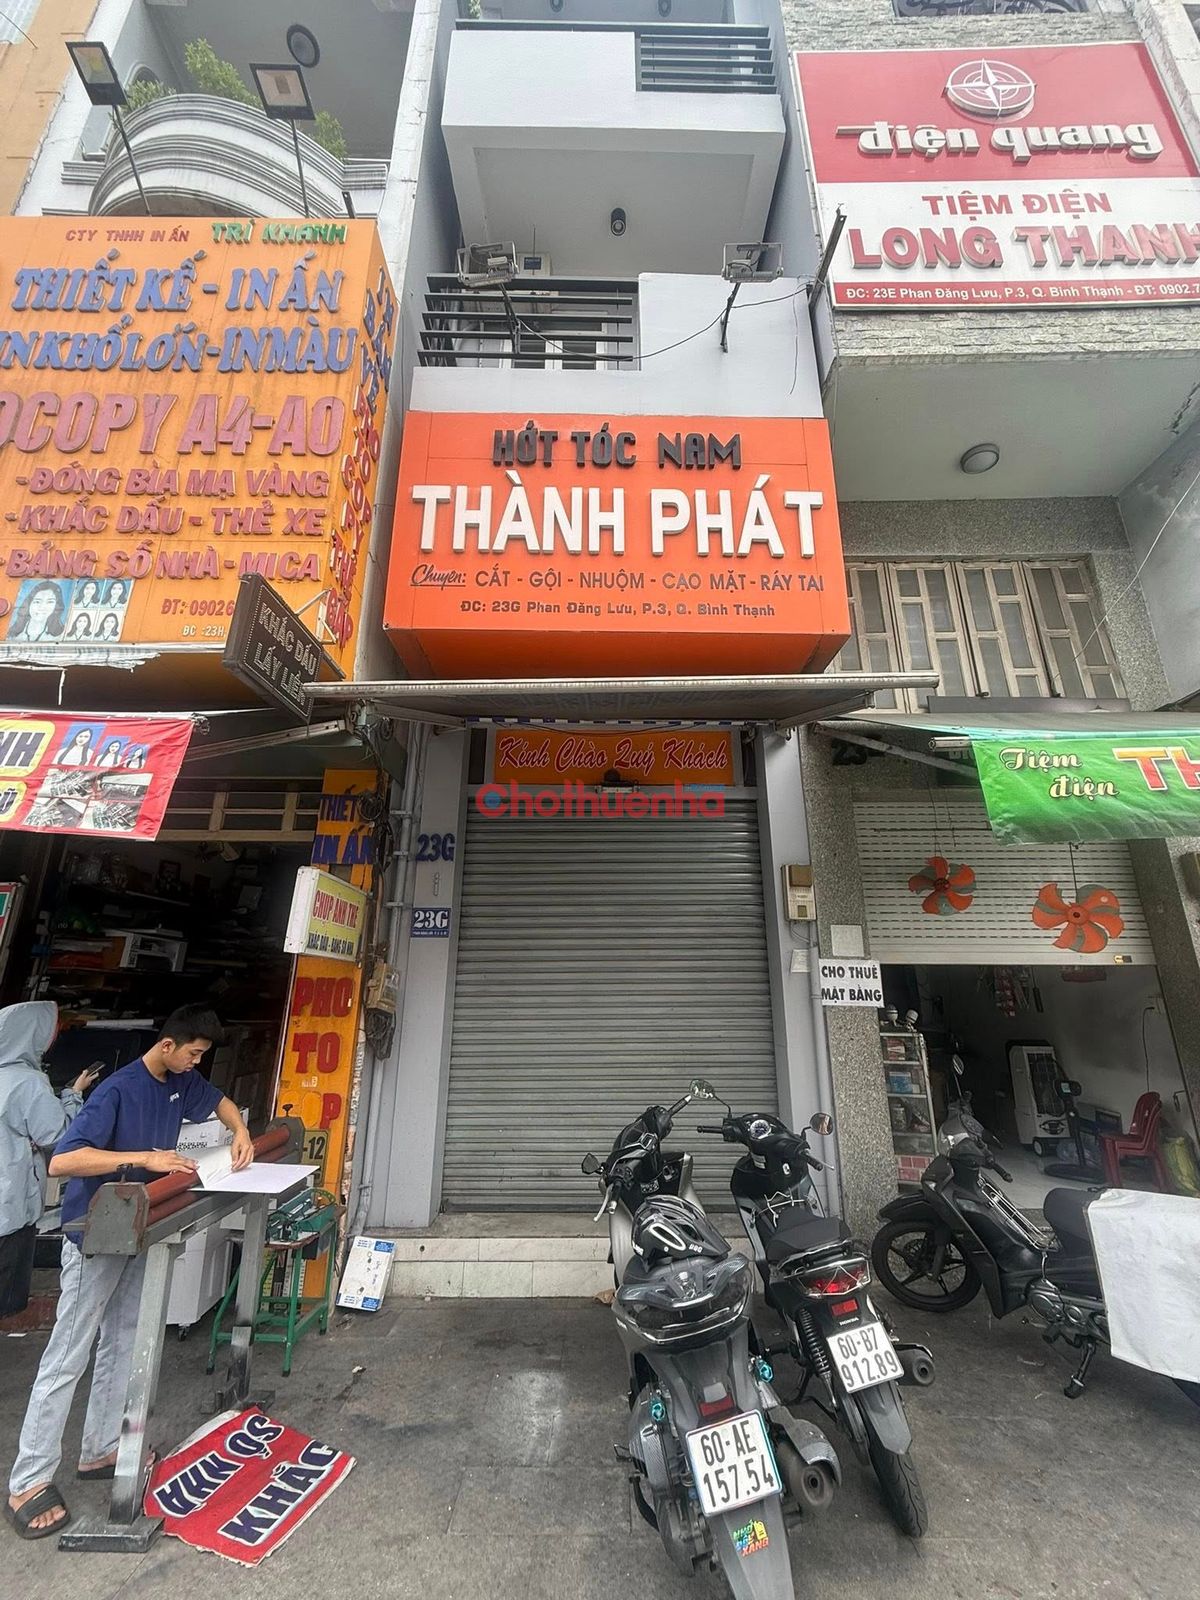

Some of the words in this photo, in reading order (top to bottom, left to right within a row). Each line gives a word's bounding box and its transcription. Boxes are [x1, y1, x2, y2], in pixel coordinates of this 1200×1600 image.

[835, 121, 980, 158] điện
[990, 122, 1165, 163] quang
[921, 190, 1014, 220] TIỆM
[1022, 188, 1113, 219] ĐIỆN
[65, 230, 98, 242] CTY
[106, 230, 145, 242] TNHH
[150, 230, 165, 242] IN
[168, 225, 191, 242] ẤN
[211, 219, 256, 244] TRÍ
[846, 226, 1004, 269] LONG
[11, 248, 137, 312] THIẾT
[136, 249, 206, 312] KẾ
[225, 268, 278, 311] IN
[279, 250, 345, 312] ẤN
[846, 288, 870, 299] ĐC:
[873, 288, 897, 298] 23E
[900, 288, 932, 298] Phan
[935, 287, 969, 300] Đăng
[972, 287, 1002, 299] Lưu,
[1005, 287, 1030, 299] P.3,
[1032, 287, 1047, 298] Q.
[1082, 285, 1124, 298] Thạnh
[1134, 285, 1157, 295] ĐT:
[493, 420, 558, 467] HỚT
[570, 422, 637, 468] TÓC
[657, 432, 741, 470] NAM
[125, 460, 179, 496] BÌA
[185, 469, 236, 499] MẠ
[246, 462, 329, 497] VÀNG
[116, 495, 185, 535] DẤU
[211, 500, 275, 535] THẺ
[282, 507, 327, 536] XE
[412, 471, 625, 556] THÀNH
[650, 474, 824, 559] PHÁT
[105, 540, 154, 579] SỐ
[155, 546, 220, 580] NHÀ
[237, 551, 321, 581] MICA
[410, 563, 467, 591] Chuyên:
[475, 563, 511, 587] CẮT
[529, 568, 561, 591] GỘI
[579, 568, 645, 592] NHUỘM
[662, 572, 701, 593] CẠO
[710, 570, 747, 594] MẶT
[760, 570, 793, 591] RÁY
[798, 574, 825, 592] TAI
[460, 600, 487, 613] ĐC:
[491, 600, 521, 613] 23G
[526, 601, 561, 614] Phan
[566, 601, 601, 616] Đăng
[607, 602, 637, 616] Lưu,
[641, 602, 672, 616] P.3,
[676, 603, 692, 616] Q.
[697, 602, 728, 616] Bình
[733, 603, 776, 618] Thạnh
[499, 736, 550, 768] Kính
[554, 736, 608, 773] Chào
[613, 737, 655, 776] Quý
[662, 737, 727, 769] Khách
[999, 747, 1083, 773] Tiệm
[1049, 774, 1120, 800] điện
[312, 834, 340, 865] IN
[416, 833, 456, 862] 23G
[413, 910, 448, 929] 23G
[821, 965, 846, 979] CHO
[848, 963, 879, 980] THUÊ
[292, 976, 355, 1018] PHO
[821, 985, 846, 1003] MẶT
[849, 983, 882, 1002] BẰNG
[292, 1031, 341, 1074] TO
[841, 1350, 898, 1388] 912.89
[703, 1454, 774, 1508] 157.54
